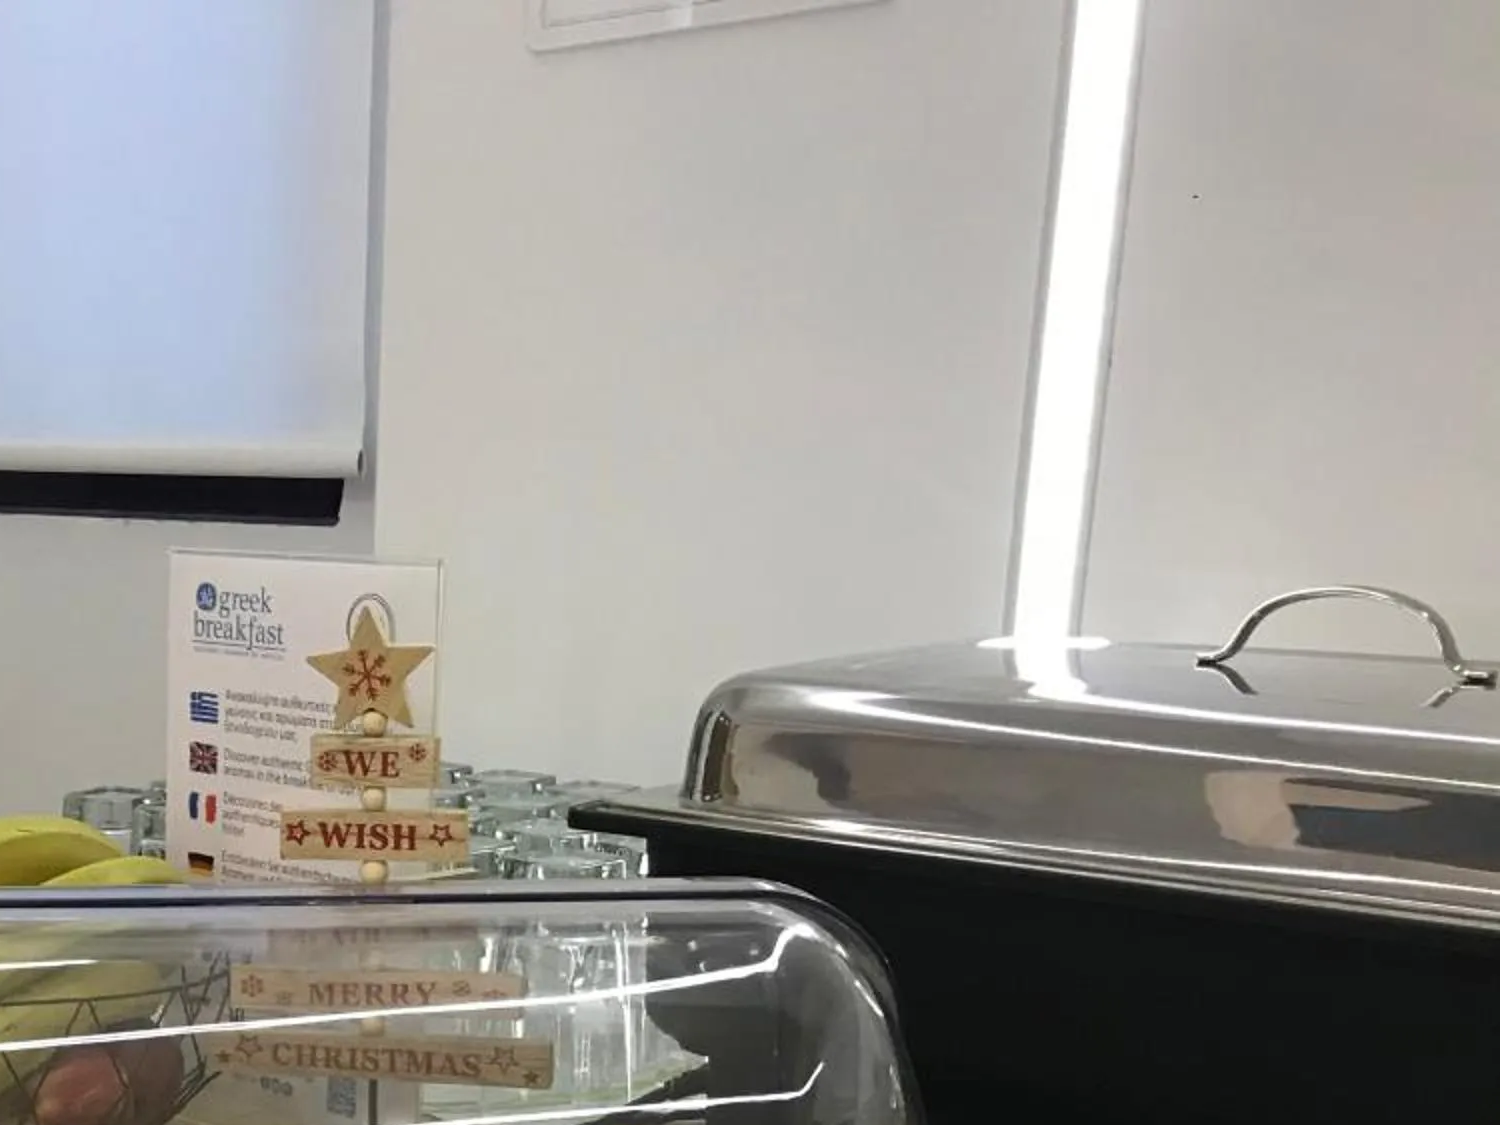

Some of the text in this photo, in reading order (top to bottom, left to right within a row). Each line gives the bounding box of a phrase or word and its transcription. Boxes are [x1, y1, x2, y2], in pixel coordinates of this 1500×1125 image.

[219, 586, 273, 619] greek
[193, 609, 285, 651] breakfast
[344, 749, 401, 779] WE
[318, 821, 417, 851] WISH
[308, 980, 437, 1006] MERRY
[271, 1042, 483, 1079] CHRISTMAS
